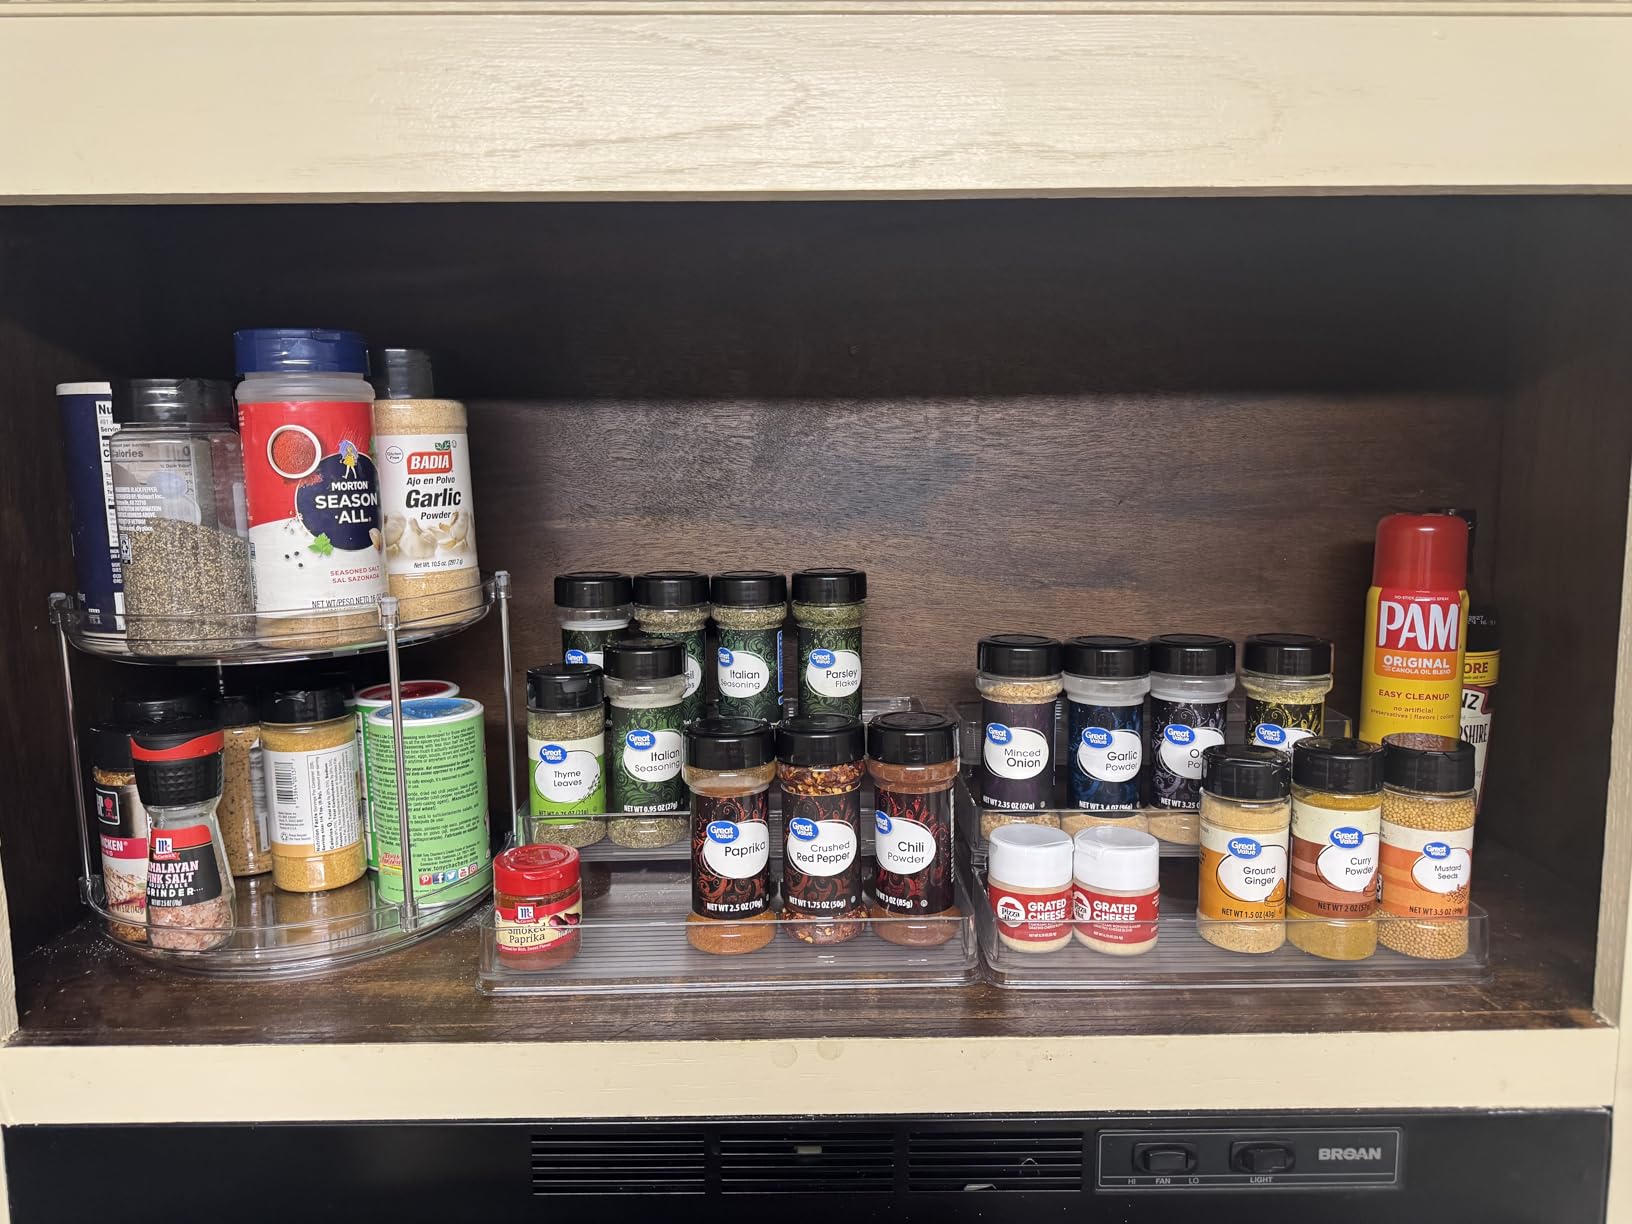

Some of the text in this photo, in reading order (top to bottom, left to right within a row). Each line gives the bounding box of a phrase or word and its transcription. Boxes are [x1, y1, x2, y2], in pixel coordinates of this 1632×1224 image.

[411, 454, 449, 470] BADIA
[332, 480, 368, 492] MORTON
[406, 477, 420, 486] Ajo
[436, 476, 455, 484] Polvo
[315, 493, 378, 509] SEASON
[406, 488, 461, 508] Garlic
[421, 512, 451, 520] Powder
[330, 568, 368, 576] SEASONED
[332, 573, 380, 584] SAL SAZONADA
[312, 600, 324, 608] NET
[1378, 600, 1459, 650] PAM
[1384, 655, 1450, 668] ORIGINAL
[1464, 662, 1488, 674] ORE
[730, 670, 760, 679] Italian
[826, 669, 857, 679] Parsley
[720, 679, 760, 689] Seasoning
[835, 680, 858, 688] Flakes
[1379, 689, 1450, 701] EASY CLEANUP
[1371, 708, 1408, 719] preservatives
[988, 727, 1006, 736] Great
[1085, 732, 1107, 740] Great
[1168, 728, 1190, 737] Great
[1258, 727, 1280, 736] Great
[992, 733, 1007, 741] Value
[542, 749, 561, 757] Great
[651, 748, 680, 762] Italian
[1004, 748, 1040, 757] Minced
[1107, 750, 1138, 760] Garlic
[635, 761, 680, 772] Seasoning
[1007, 758, 1040, 768] Onion
[1106, 763, 1138, 771] Powder
[554, 771, 581, 780] Thyme
[554, 779, 582, 787] Leaves
[990, 798, 997, 806] WT
[998, 800, 1010, 809] 2.35
[1079, 801, 1089, 809] NET
[1161, 797, 1171, 805] NET
[644, 804, 656, 812] 0.95
[657, 803, 665, 811] OZ
[665, 802, 678, 811] (27g)
[710, 826, 733, 834] Great
[792, 823, 812, 833] Great
[796, 829, 814, 837] Value
[1334, 830, 1358, 840] Great
[725, 841, 766, 857] Paprika
[810, 842, 850, 852] Crushed
[898, 842, 924, 852] Chili
[1231, 841, 1256, 851] Great
[797, 852, 850, 864] Red Pepper
[888, 852, 924, 863] Powder
[1350, 857, 1371, 866] Curry
[1243, 866, 1276, 875] Ground
[1345, 866, 1374, 876] Powder
[1434, 864, 1462, 872] Mustard
[165, 872, 194, 884] SALT
[1244, 876, 1275, 886] Ginger
[1438, 872, 1458, 880] Seeds
[147, 887, 194, 898] GRINDER
[707, 899, 762, 912] NET WT 2.5 OZ (70g)
[789, 896, 797, 905] NET
[798, 897, 807, 907] WT
[808, 899, 820, 908] 1.75
[831, 899, 846, 909] (50g)
[889, 895, 896, 904] OZ
[897, 898, 913, 908] (85g)
[1028, 898, 1066, 911] GRATED
[1074, 904, 1087, 914] Pizza
[1093, 901, 1137, 913] GRATED
[1318, 902, 1330, 910] NET
[1332, 903, 1343, 911] WT
[1344, 904, 1348, 912] 2
[1409, 905, 1421, 913] NET
[1002, 908, 1020, 918] Pizza
[1028, 908, 1066, 921] CHEESE
[1093, 910, 1135, 921] CHEESE
[1222, 908, 1232, 916] NET
[1233, 909, 1243, 917] WT
[1245, 910, 1254, 918] 1.5
[508, 922, 546, 935] Smoked
[509, 932, 545, 945] Paprika
[1318, 1148, 1382, 1160] BROAN
